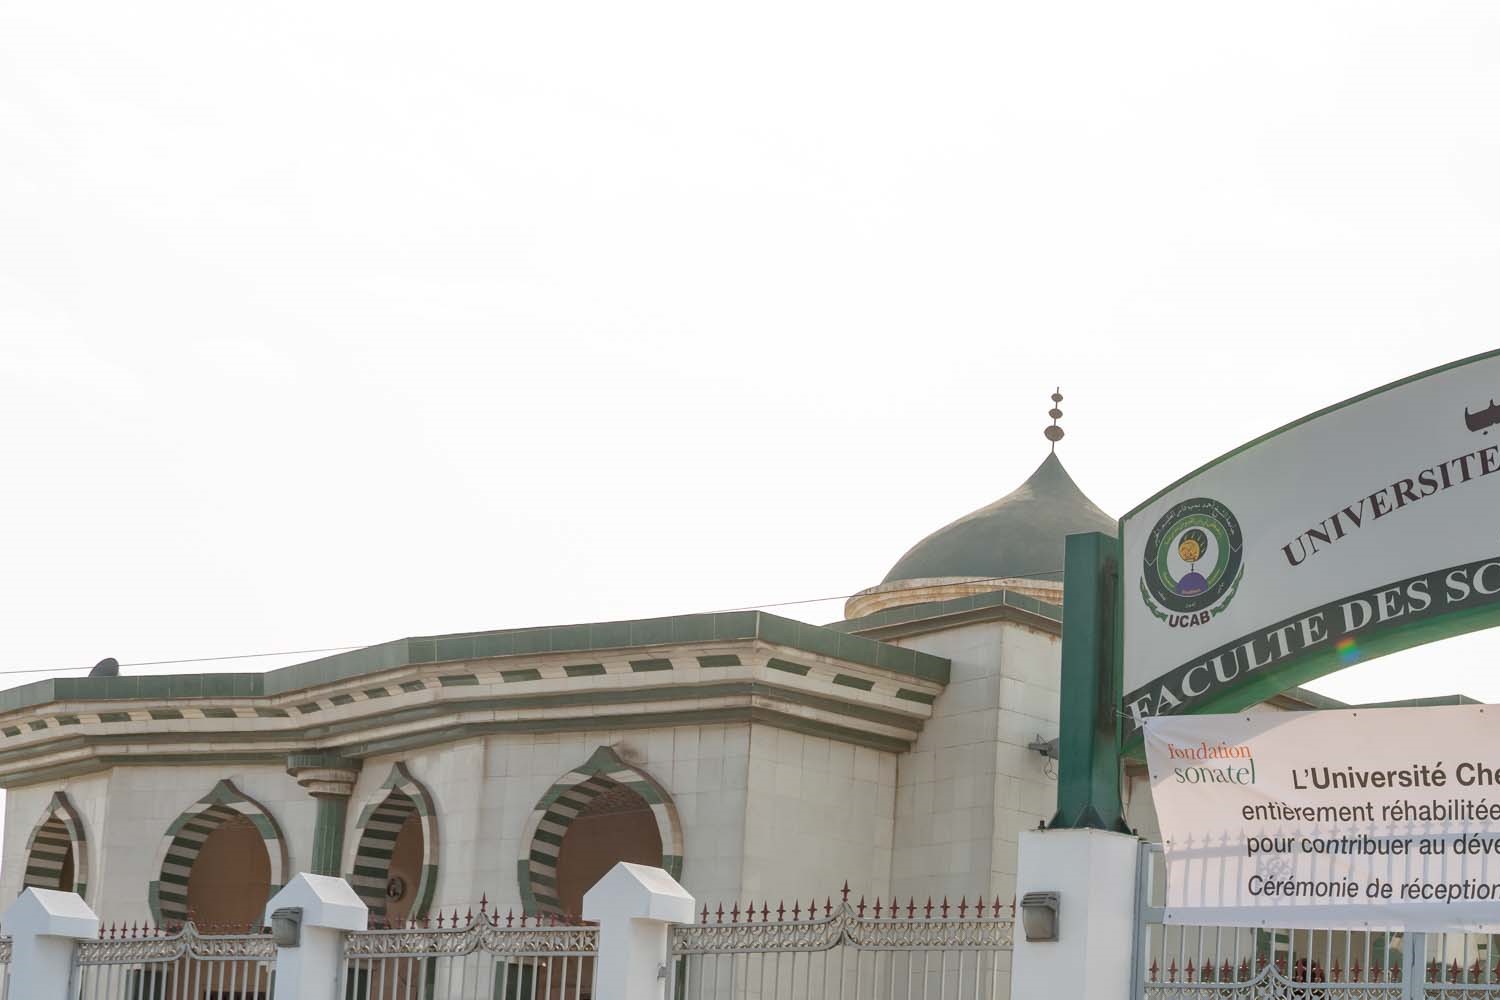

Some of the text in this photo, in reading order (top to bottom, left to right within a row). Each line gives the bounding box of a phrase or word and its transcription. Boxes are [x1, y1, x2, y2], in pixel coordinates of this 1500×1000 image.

[1168, 610, 1211, 628] UCAB
[1126, 613, 1328, 730] FACULTE
[1340, 579, 1432, 634] DES
[1168, 741, 1252, 761] fondation
[1174, 758, 1256, 785] sonatel
[1293, 761, 1447, 790] L’Université
[1242, 801, 1374, 822] entièrement
[1247, 837, 1295, 857] pour
[1302, 834, 1413, 855] contribuer
[1419, 838, 1445, 855] au
[1248, 875, 1359, 898] Cérémonie
[1366, 878, 1393, 899] de
